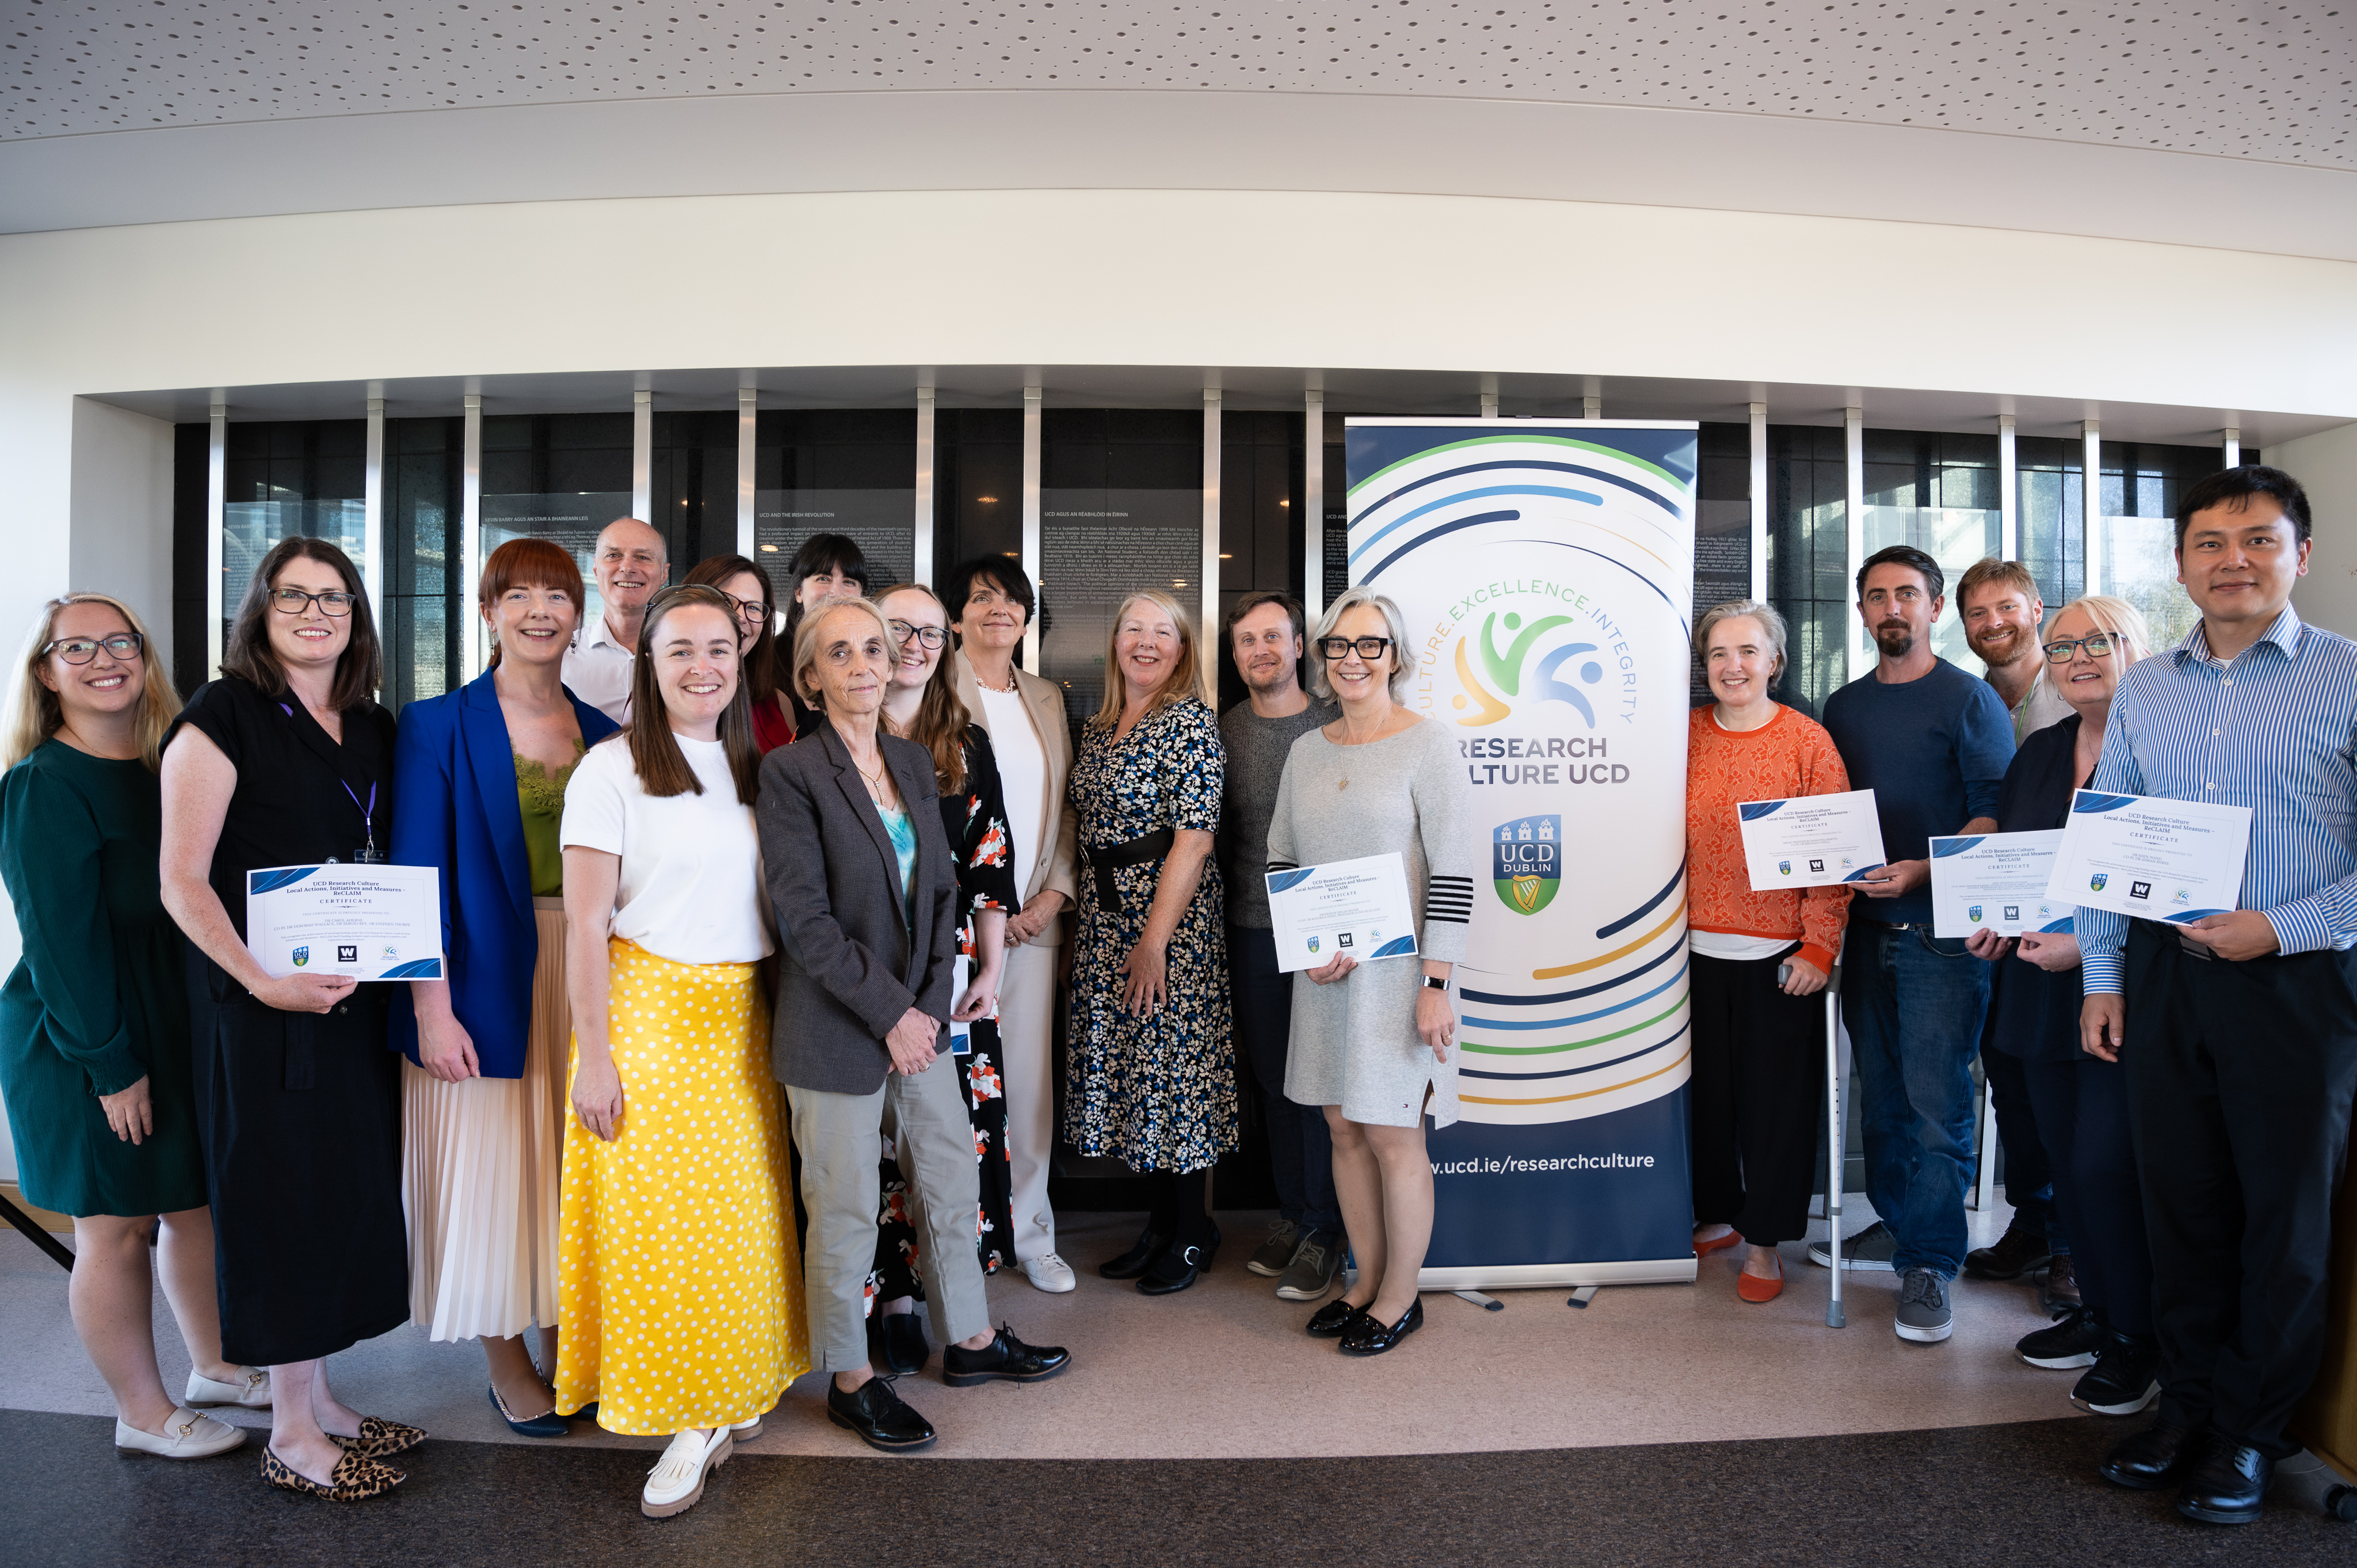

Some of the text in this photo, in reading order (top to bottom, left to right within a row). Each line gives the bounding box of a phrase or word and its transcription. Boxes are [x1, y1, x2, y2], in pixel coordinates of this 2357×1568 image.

[1469, 764, 1630, 784] LTURE UCD
[2142, 814, 2167, 822] Research
[2119, 817, 2141, 825] Actions,
[2142, 819, 2170, 828] Initiatives
[2183, 825, 2210, 833] Measures
[2130, 832, 2178, 843] CERTIFICATE
[1501, 844, 1554, 863] UCD
[1504, 863, 1551, 872] DUBLIN
[1319, 891, 1356, 900] CERTIFICATE
[1431, 1153, 1654, 1174] w.ucd.ie/researchculture
